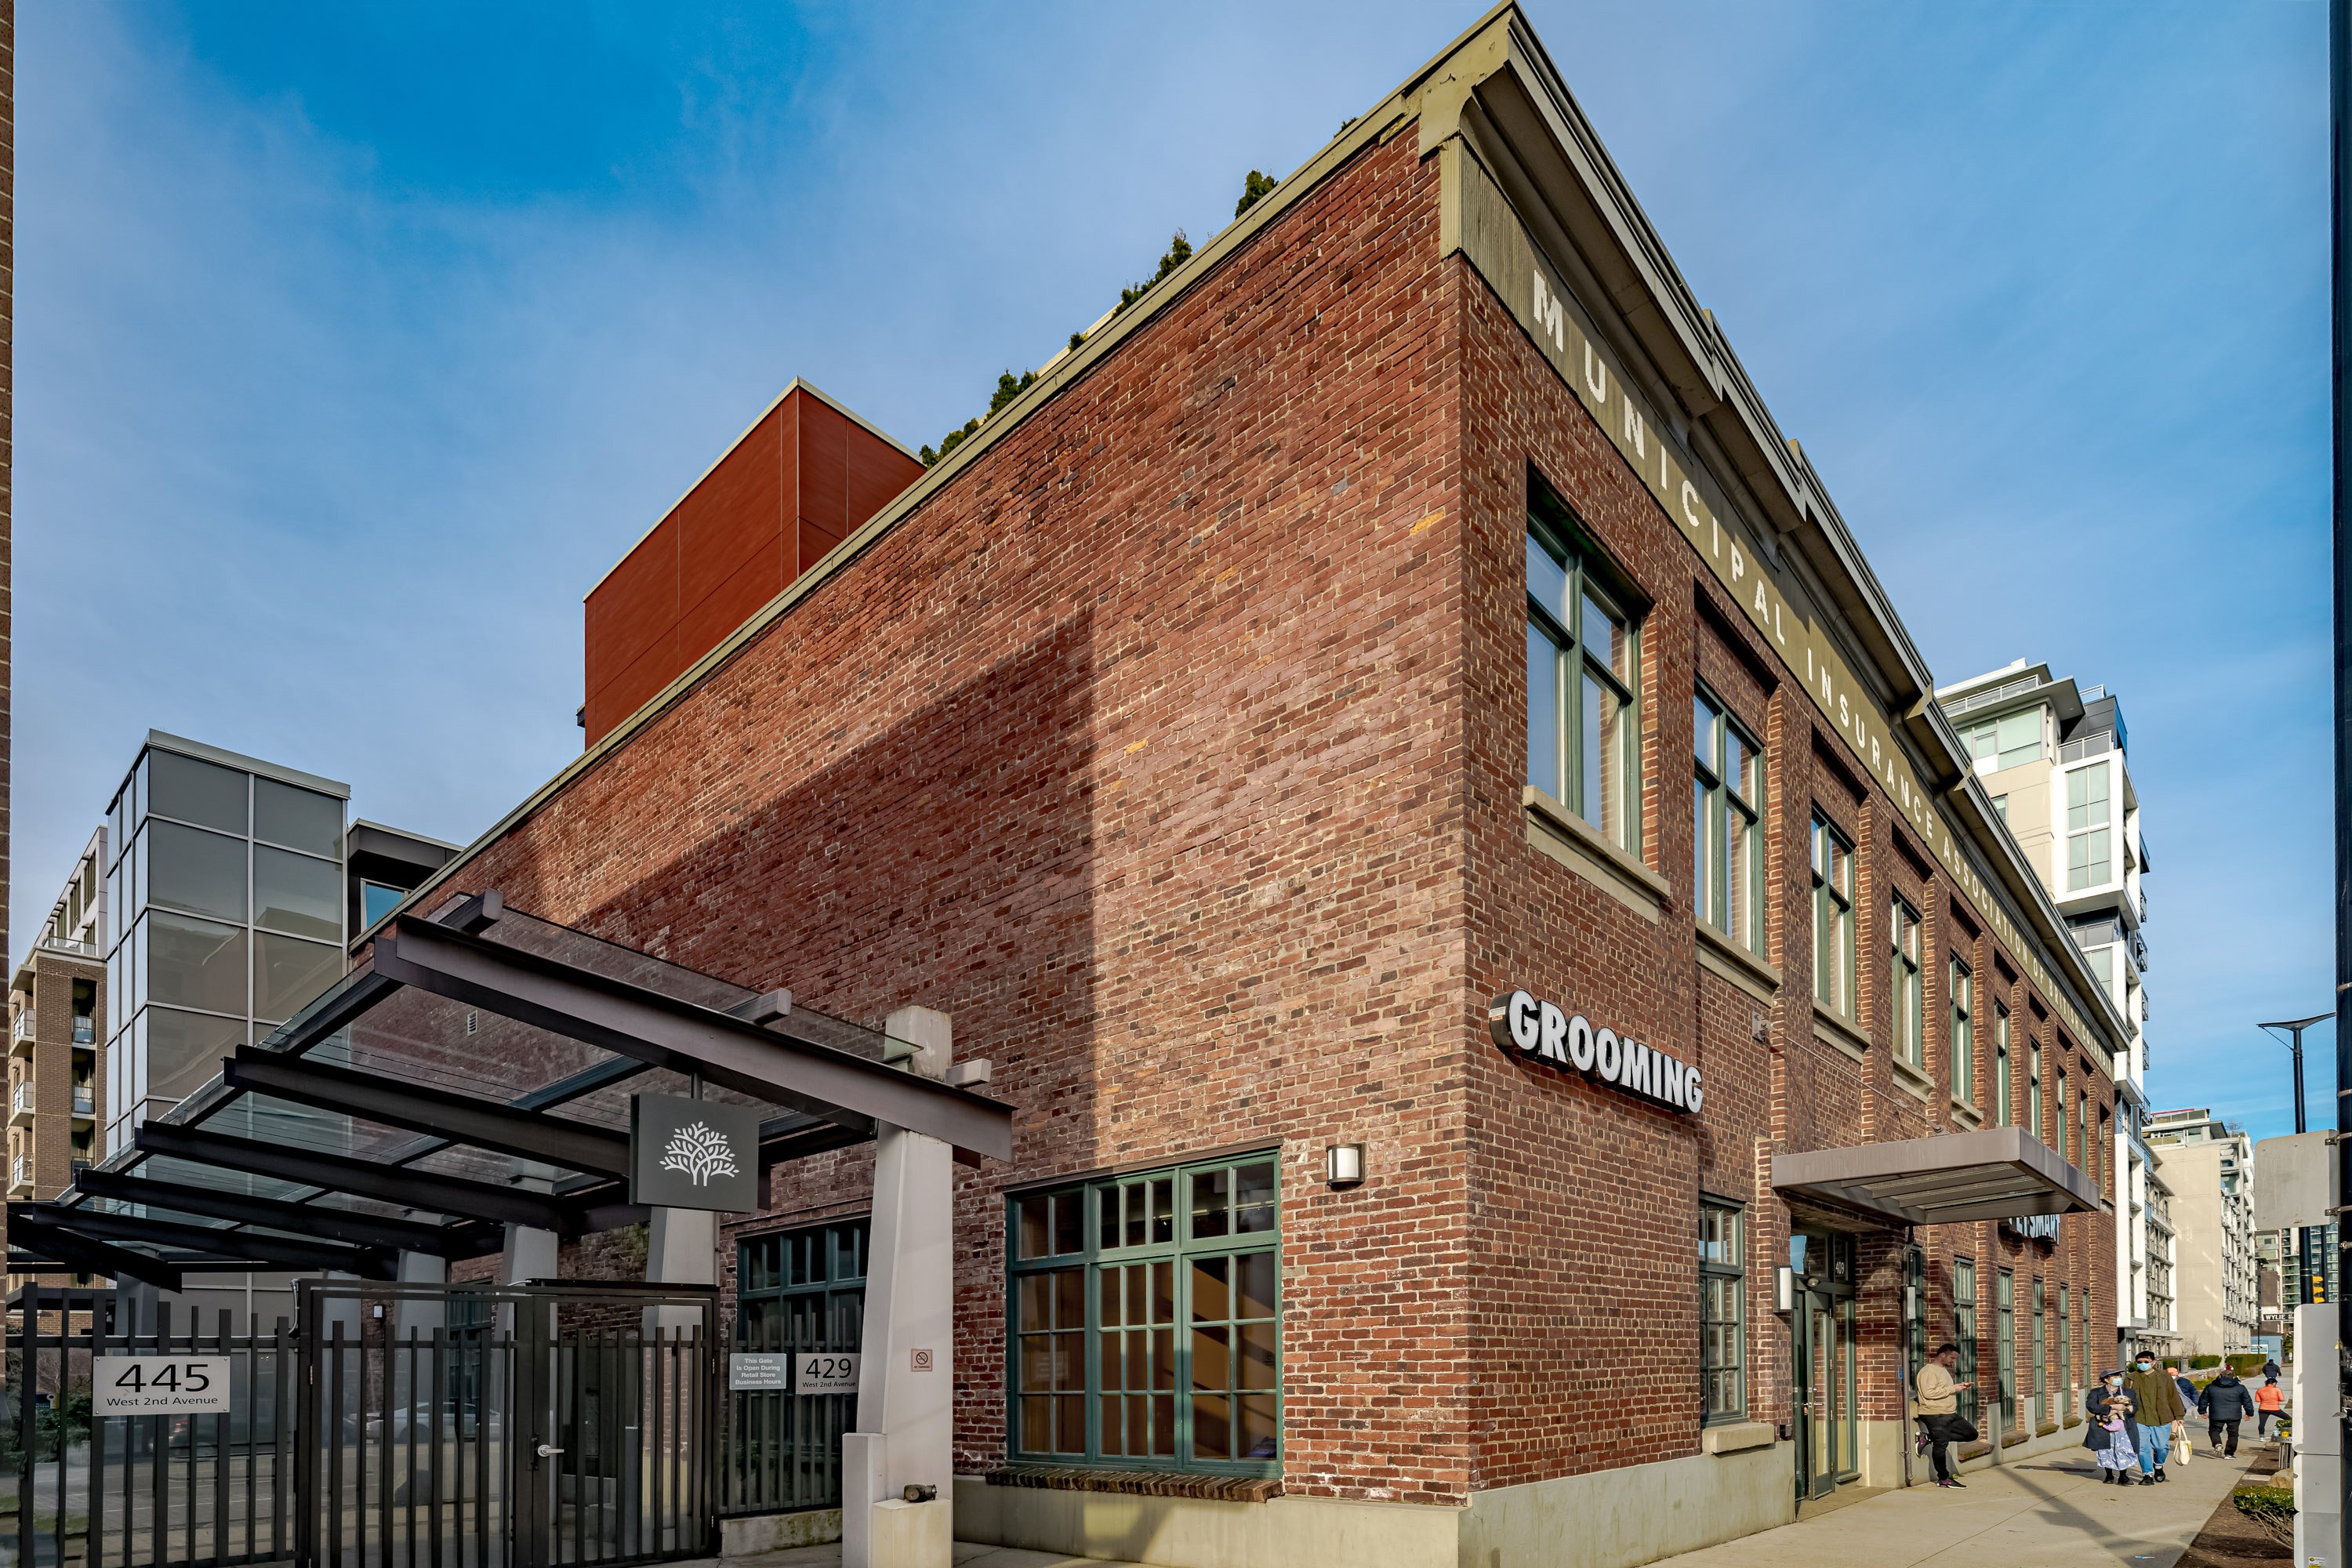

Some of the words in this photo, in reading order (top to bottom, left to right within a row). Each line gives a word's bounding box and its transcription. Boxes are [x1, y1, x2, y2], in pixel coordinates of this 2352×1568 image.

[1534, 269, 1785, 646] MUNICIPAL
[1807, 647, 1933, 839] INSURANCE
[1943, 836, 2028, 964] ASSOCIATION
[2033, 957, 2045, 985] OF
[2049, 978, 2079, 1032] BRITISH
[1508, 989, 1704, 1113] GROOMING
[1835, 1261, 1845, 1275] 409
[115, 1364, 209, 1392] 445
[805, 1358, 852, 1378] 429
